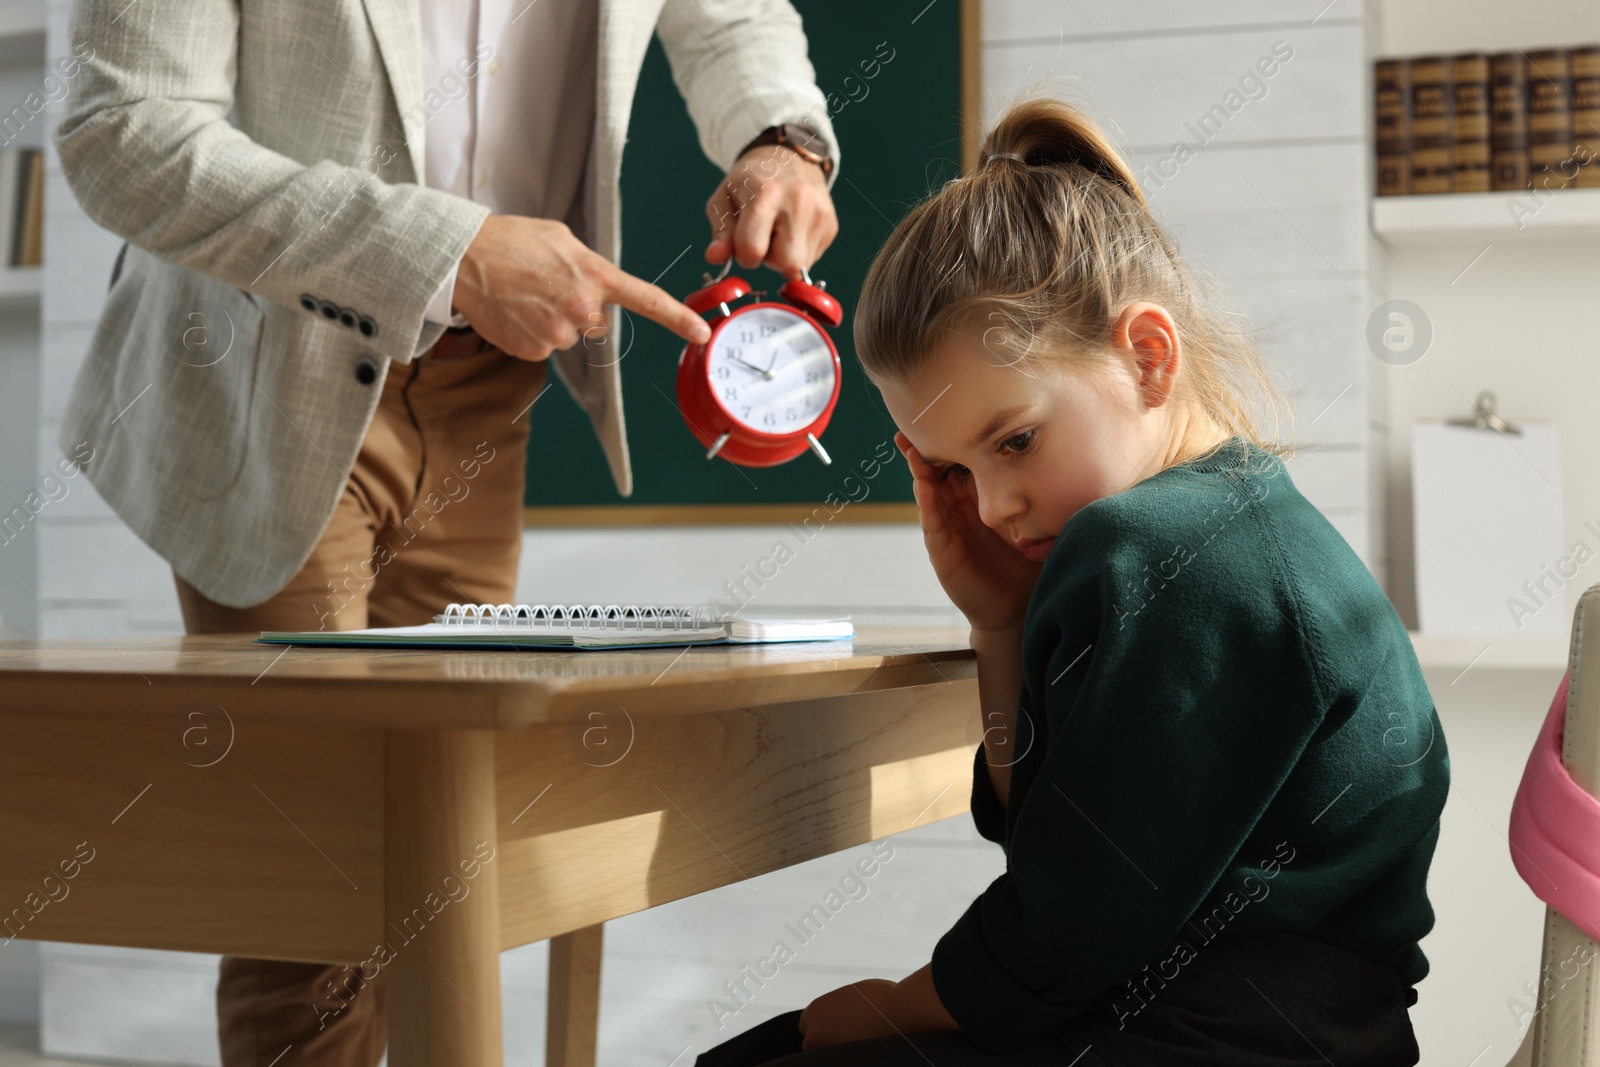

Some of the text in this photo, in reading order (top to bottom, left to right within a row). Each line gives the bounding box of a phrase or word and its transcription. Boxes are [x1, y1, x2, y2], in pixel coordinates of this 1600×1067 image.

[741, 331, 754, 344] 11
[760, 325, 777, 338] 12
[726, 347, 743, 360] 10
[718, 367, 730, 380] 9
[725, 387, 738, 401] 8
[741, 405, 752, 419] 7
[785, 406, 798, 421] 5
[763, 412, 776, 427] 6
